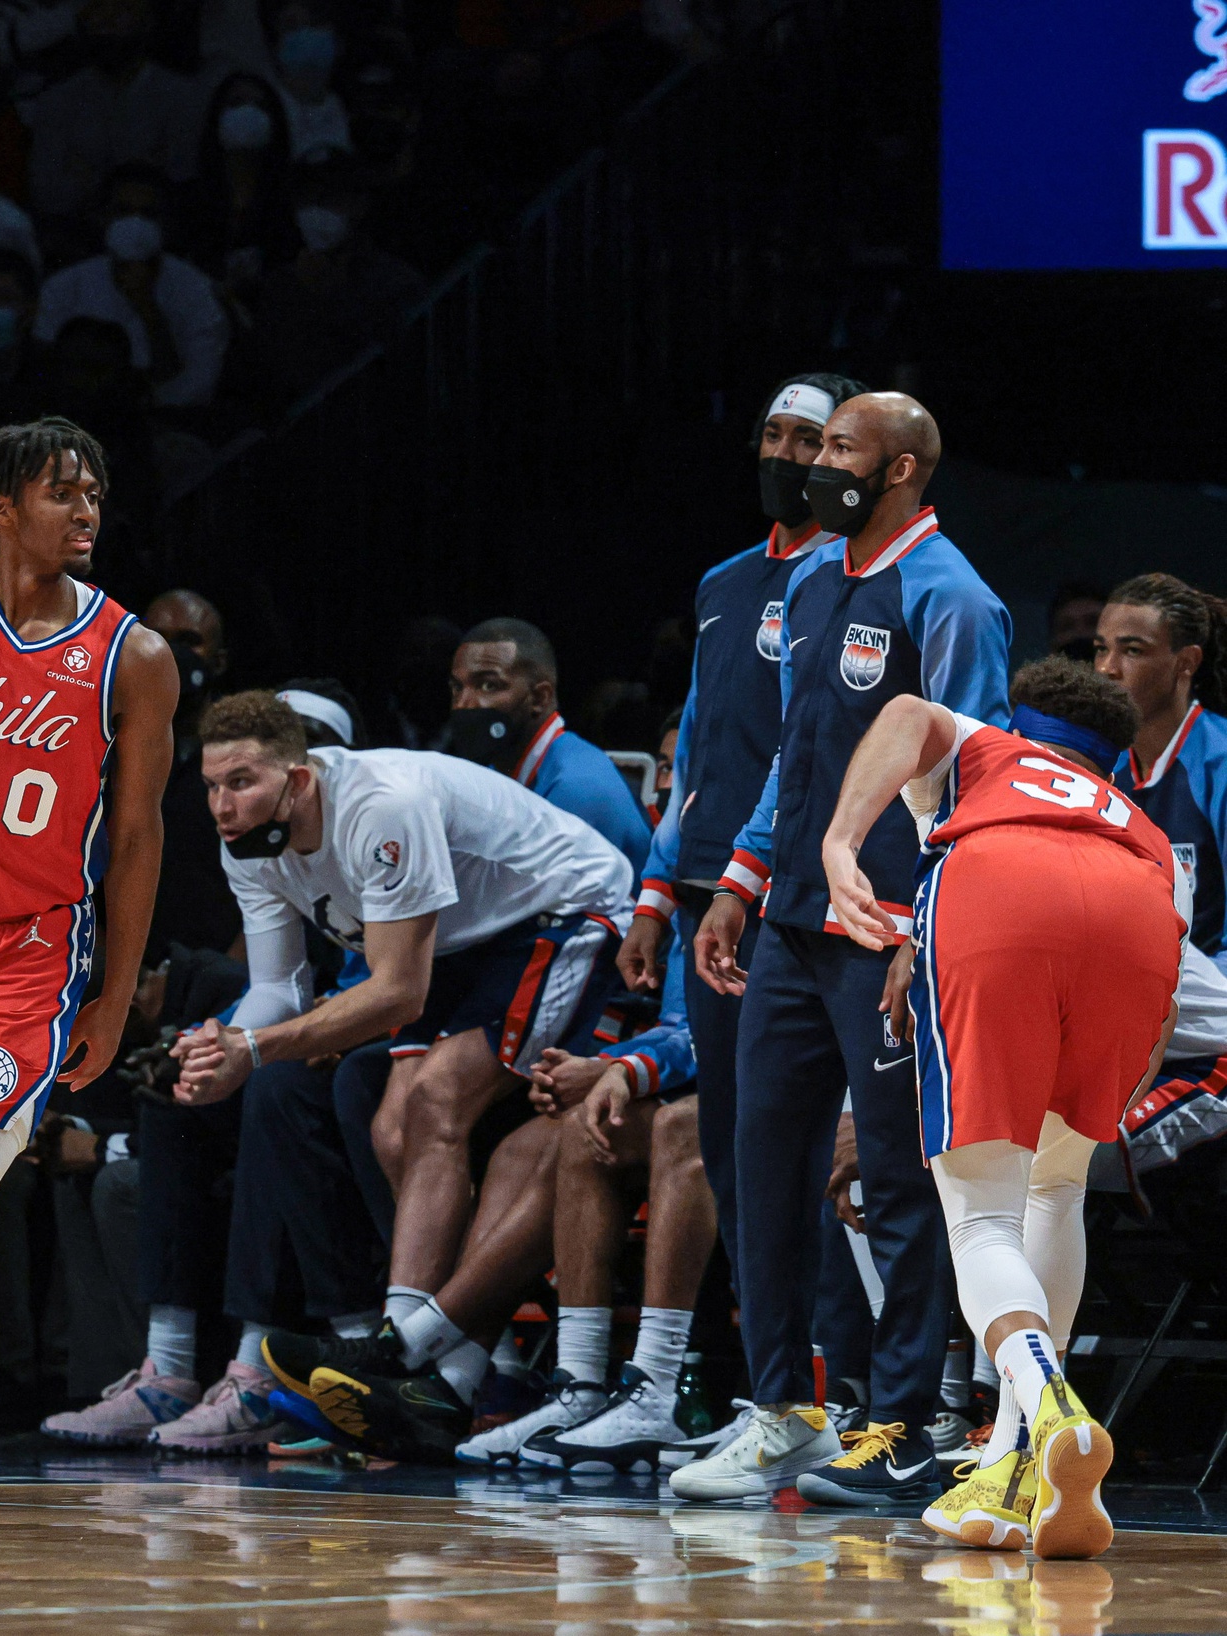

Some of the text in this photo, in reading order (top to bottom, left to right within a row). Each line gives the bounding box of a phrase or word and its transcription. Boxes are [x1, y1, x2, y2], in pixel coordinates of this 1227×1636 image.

[1154, 140, 1227, 241] R
[846, 627, 887, 653] BKLYN
[47, 671, 95, 689] crypto.com
[2, 768, 58, 837] 0
